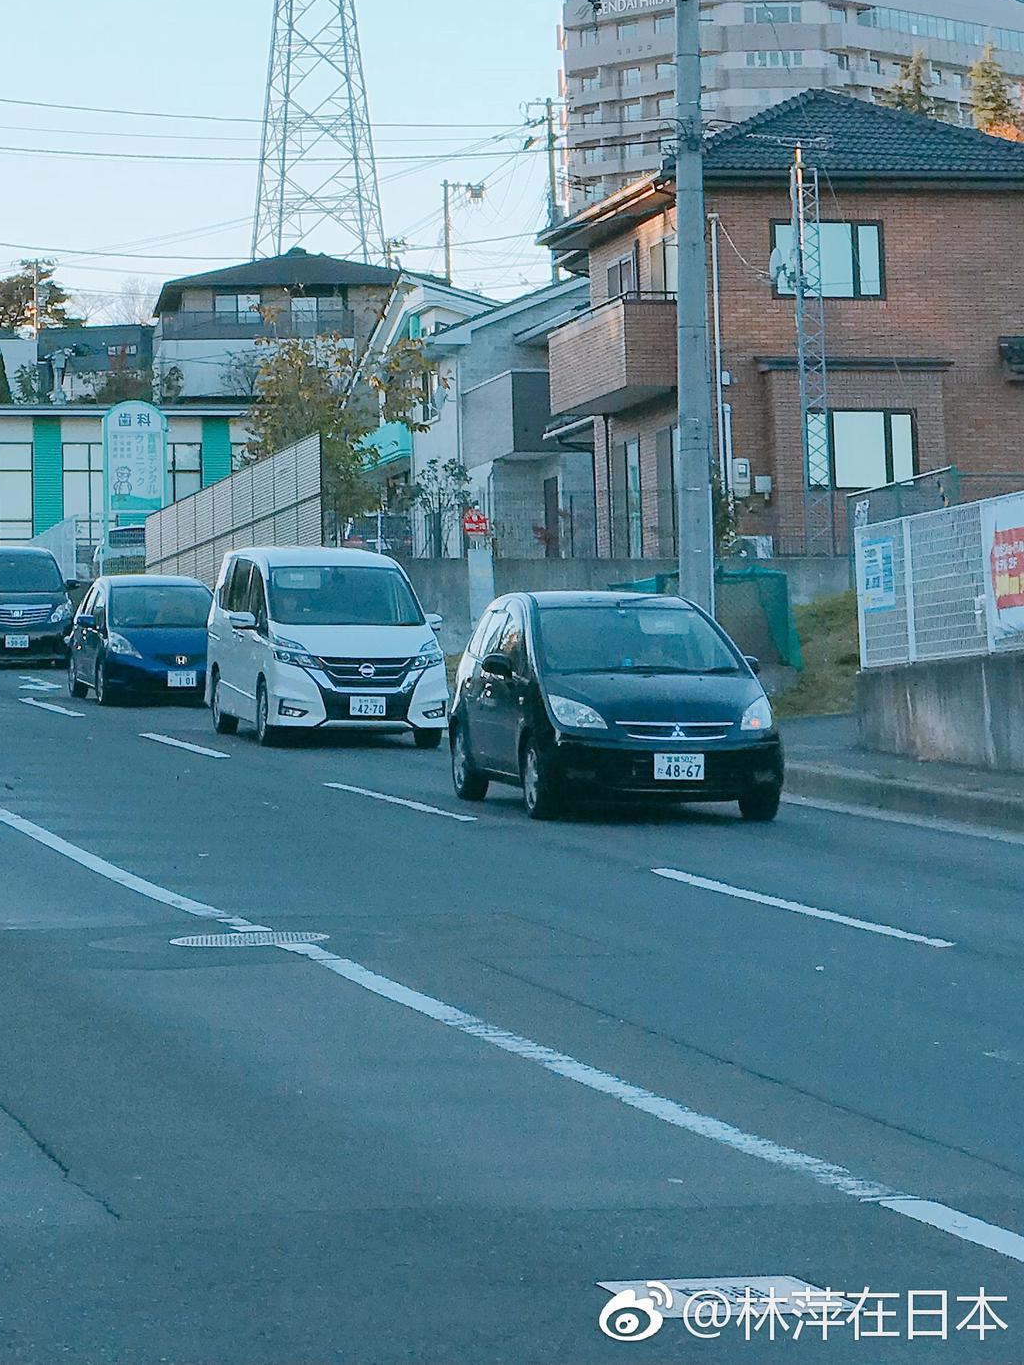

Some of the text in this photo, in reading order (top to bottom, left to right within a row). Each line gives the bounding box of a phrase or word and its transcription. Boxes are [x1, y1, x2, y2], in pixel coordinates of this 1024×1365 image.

[119, 413, 151, 426] 歯科
[136, 435, 144, 486] クリニック
[358, 704, 384, 715] 42-70
[666, 764, 701, 777] 48-67
